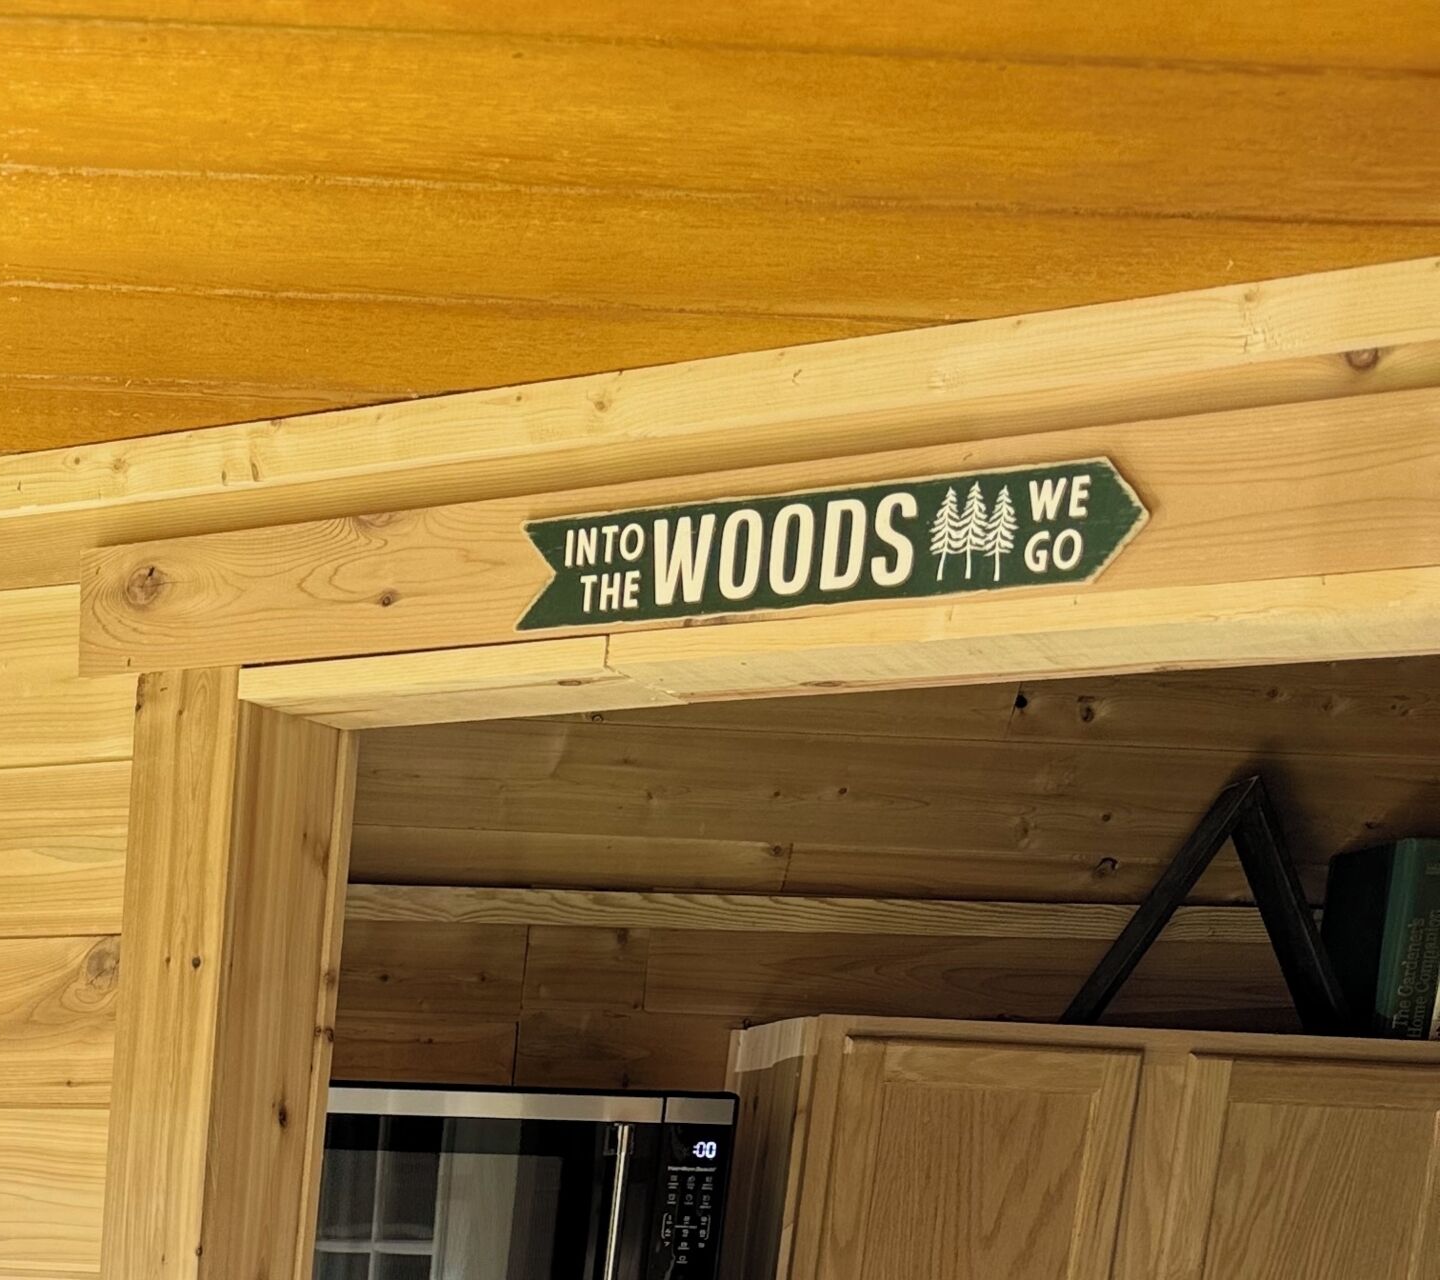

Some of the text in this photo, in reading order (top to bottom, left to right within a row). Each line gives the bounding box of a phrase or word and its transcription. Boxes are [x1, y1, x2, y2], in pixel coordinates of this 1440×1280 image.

[1029, 475, 1091, 521] WE
[564, 523, 644, 567] INTO
[654, 492, 917, 605] WOODS
[1024, 528, 1083, 573] GO
[580, 570, 640, 612] THE
[1392, 918, 1425, 1029] The Gardener's
[1407, 996, 1426, 1038] Home
